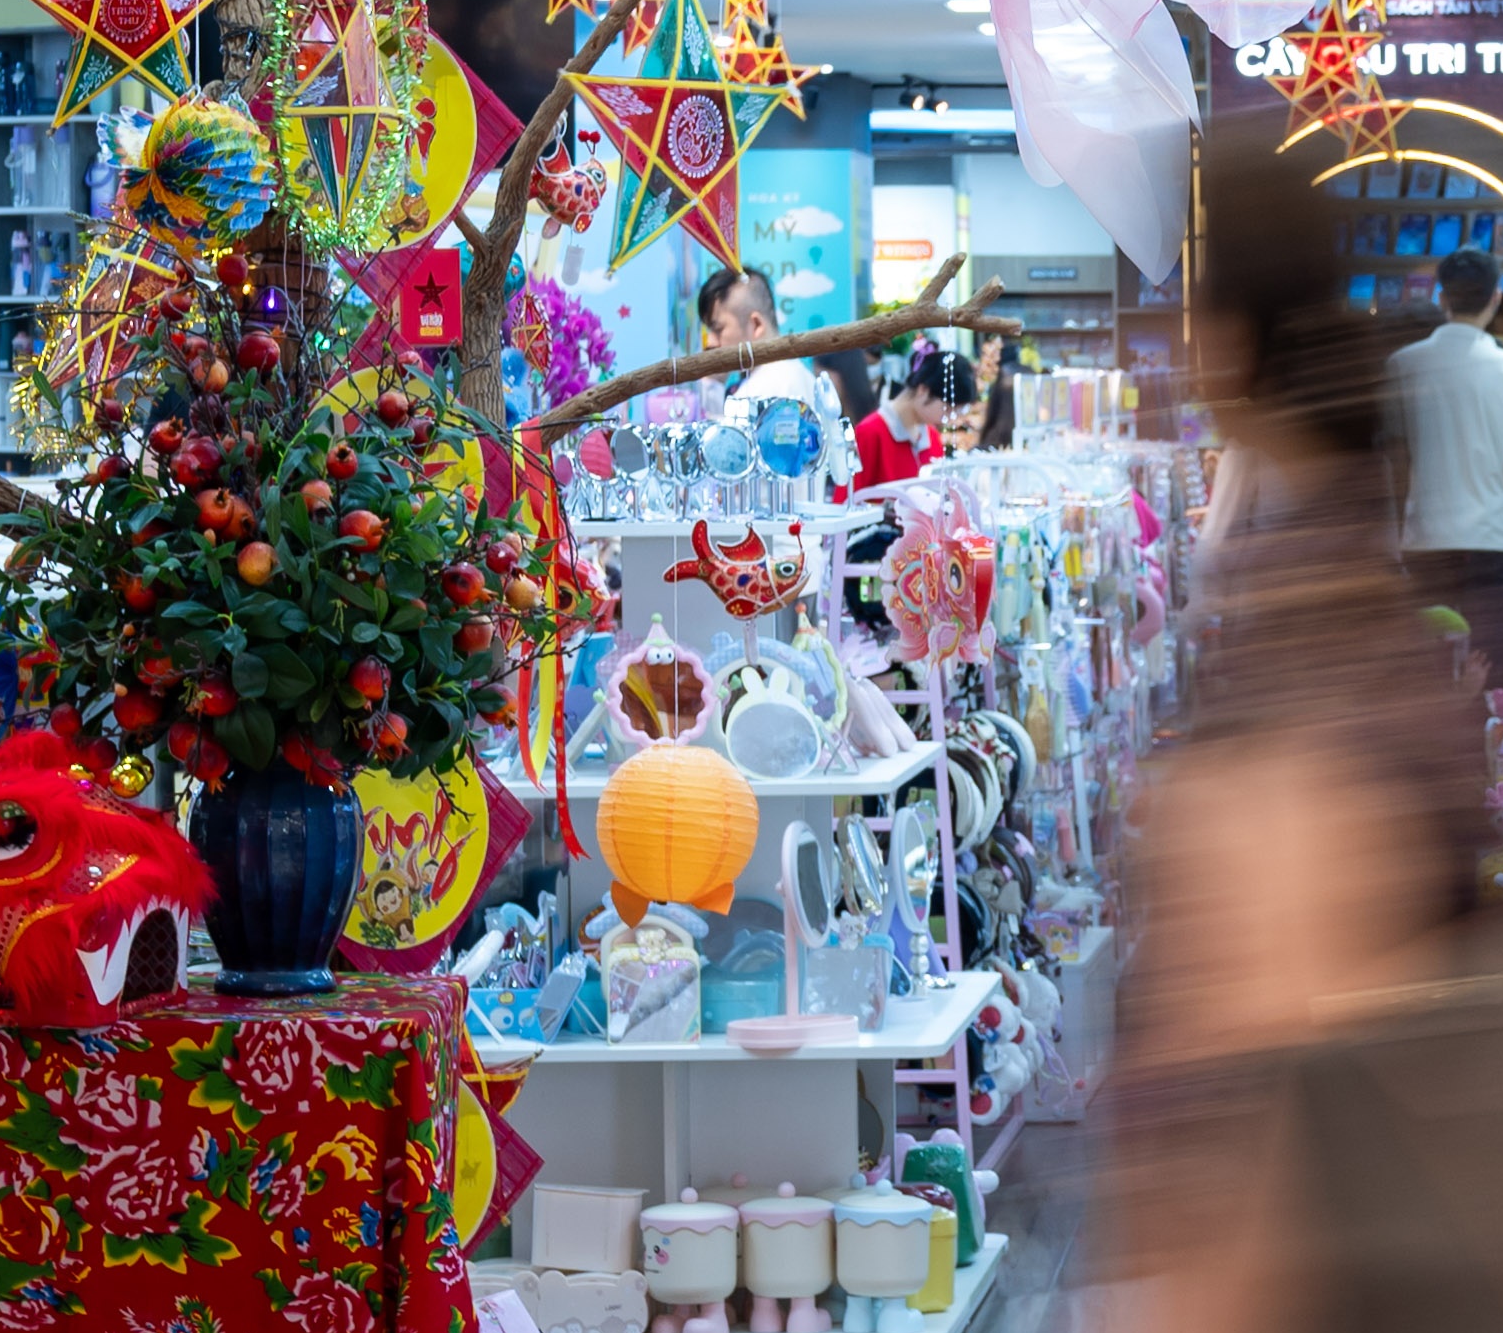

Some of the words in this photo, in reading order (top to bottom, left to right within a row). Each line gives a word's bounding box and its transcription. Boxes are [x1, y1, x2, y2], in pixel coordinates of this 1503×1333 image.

[110, 5, 147, 16] TRUNG
[118, 15, 140, 26] THU
[1235, 36, 1307, 77] CÂY
[1402, 42, 1466, 75] TRI
